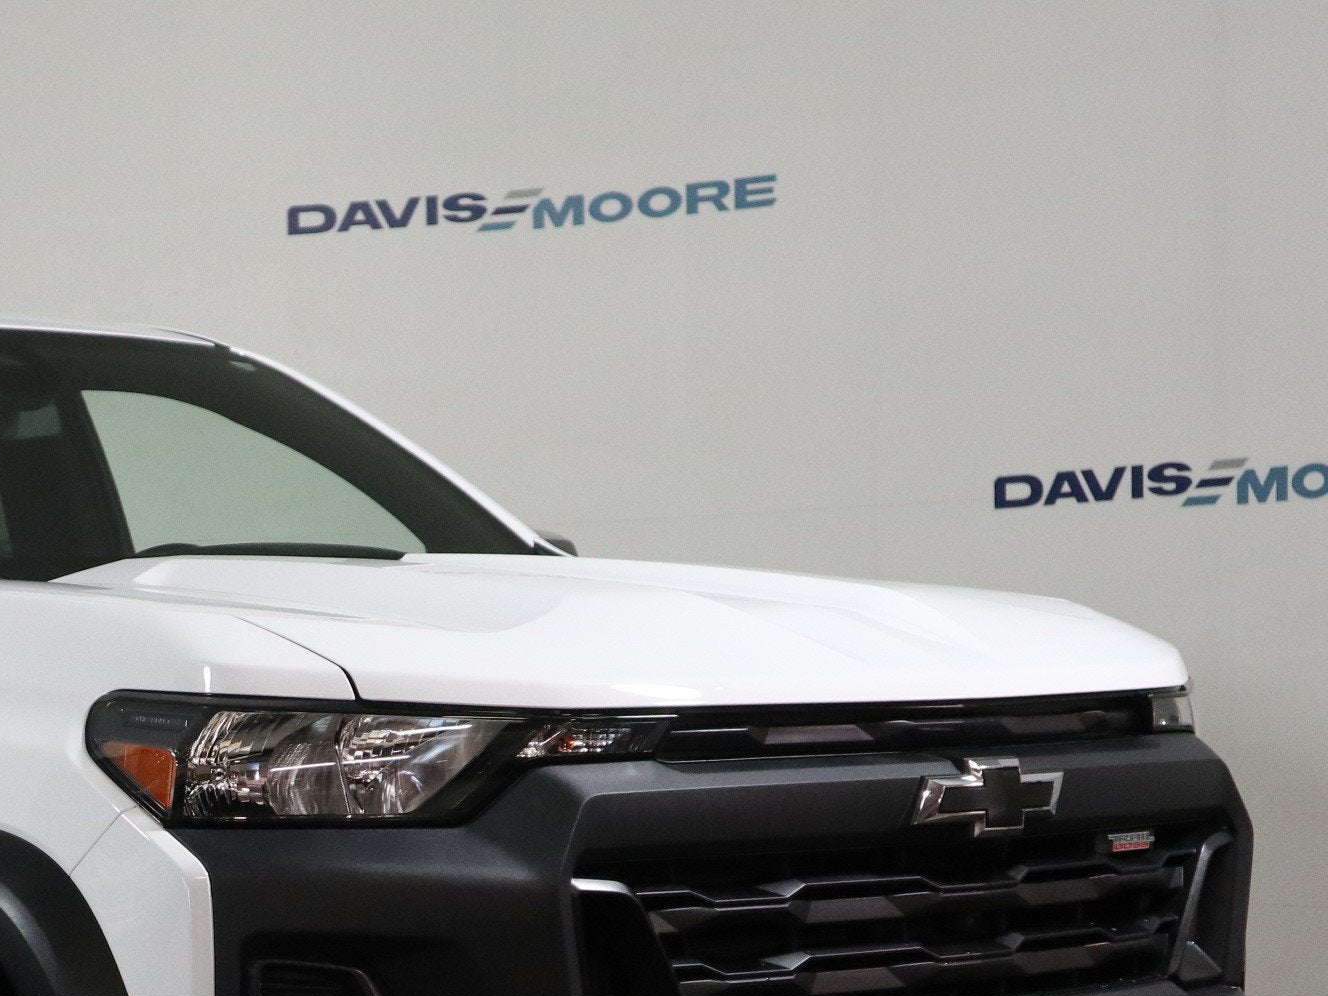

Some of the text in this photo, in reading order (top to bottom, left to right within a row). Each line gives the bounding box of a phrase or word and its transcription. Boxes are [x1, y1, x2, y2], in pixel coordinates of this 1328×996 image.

[286, 173, 778, 236] DAVIS MOORE
[994, 461, 1193, 509] DAVIS
